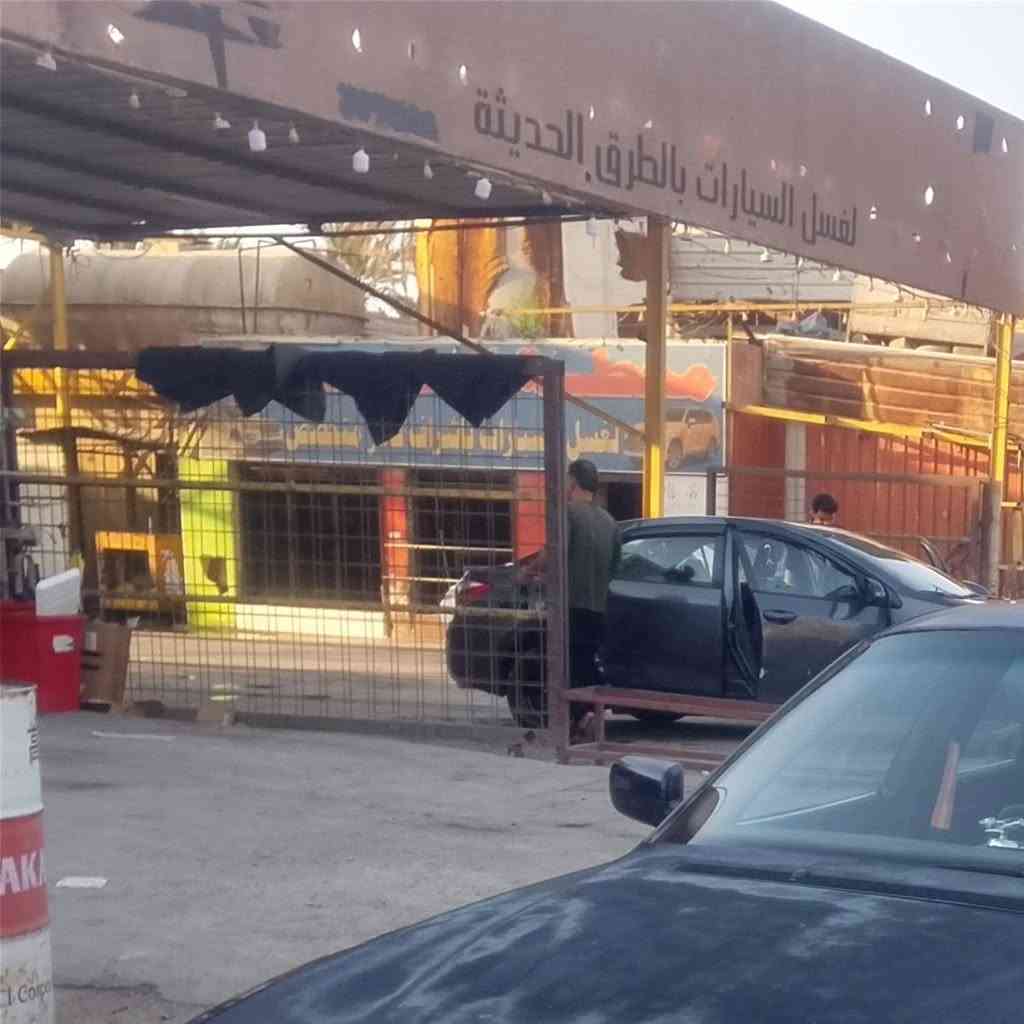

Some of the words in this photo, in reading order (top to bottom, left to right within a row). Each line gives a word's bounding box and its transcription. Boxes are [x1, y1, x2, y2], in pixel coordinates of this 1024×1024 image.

[473, 86, 585, 165] الحديثة
[594, 129, 686, 202] بالطرق
[696, 157, 795, 229] السيارات
[801, 192, 857, 247] لغسل
